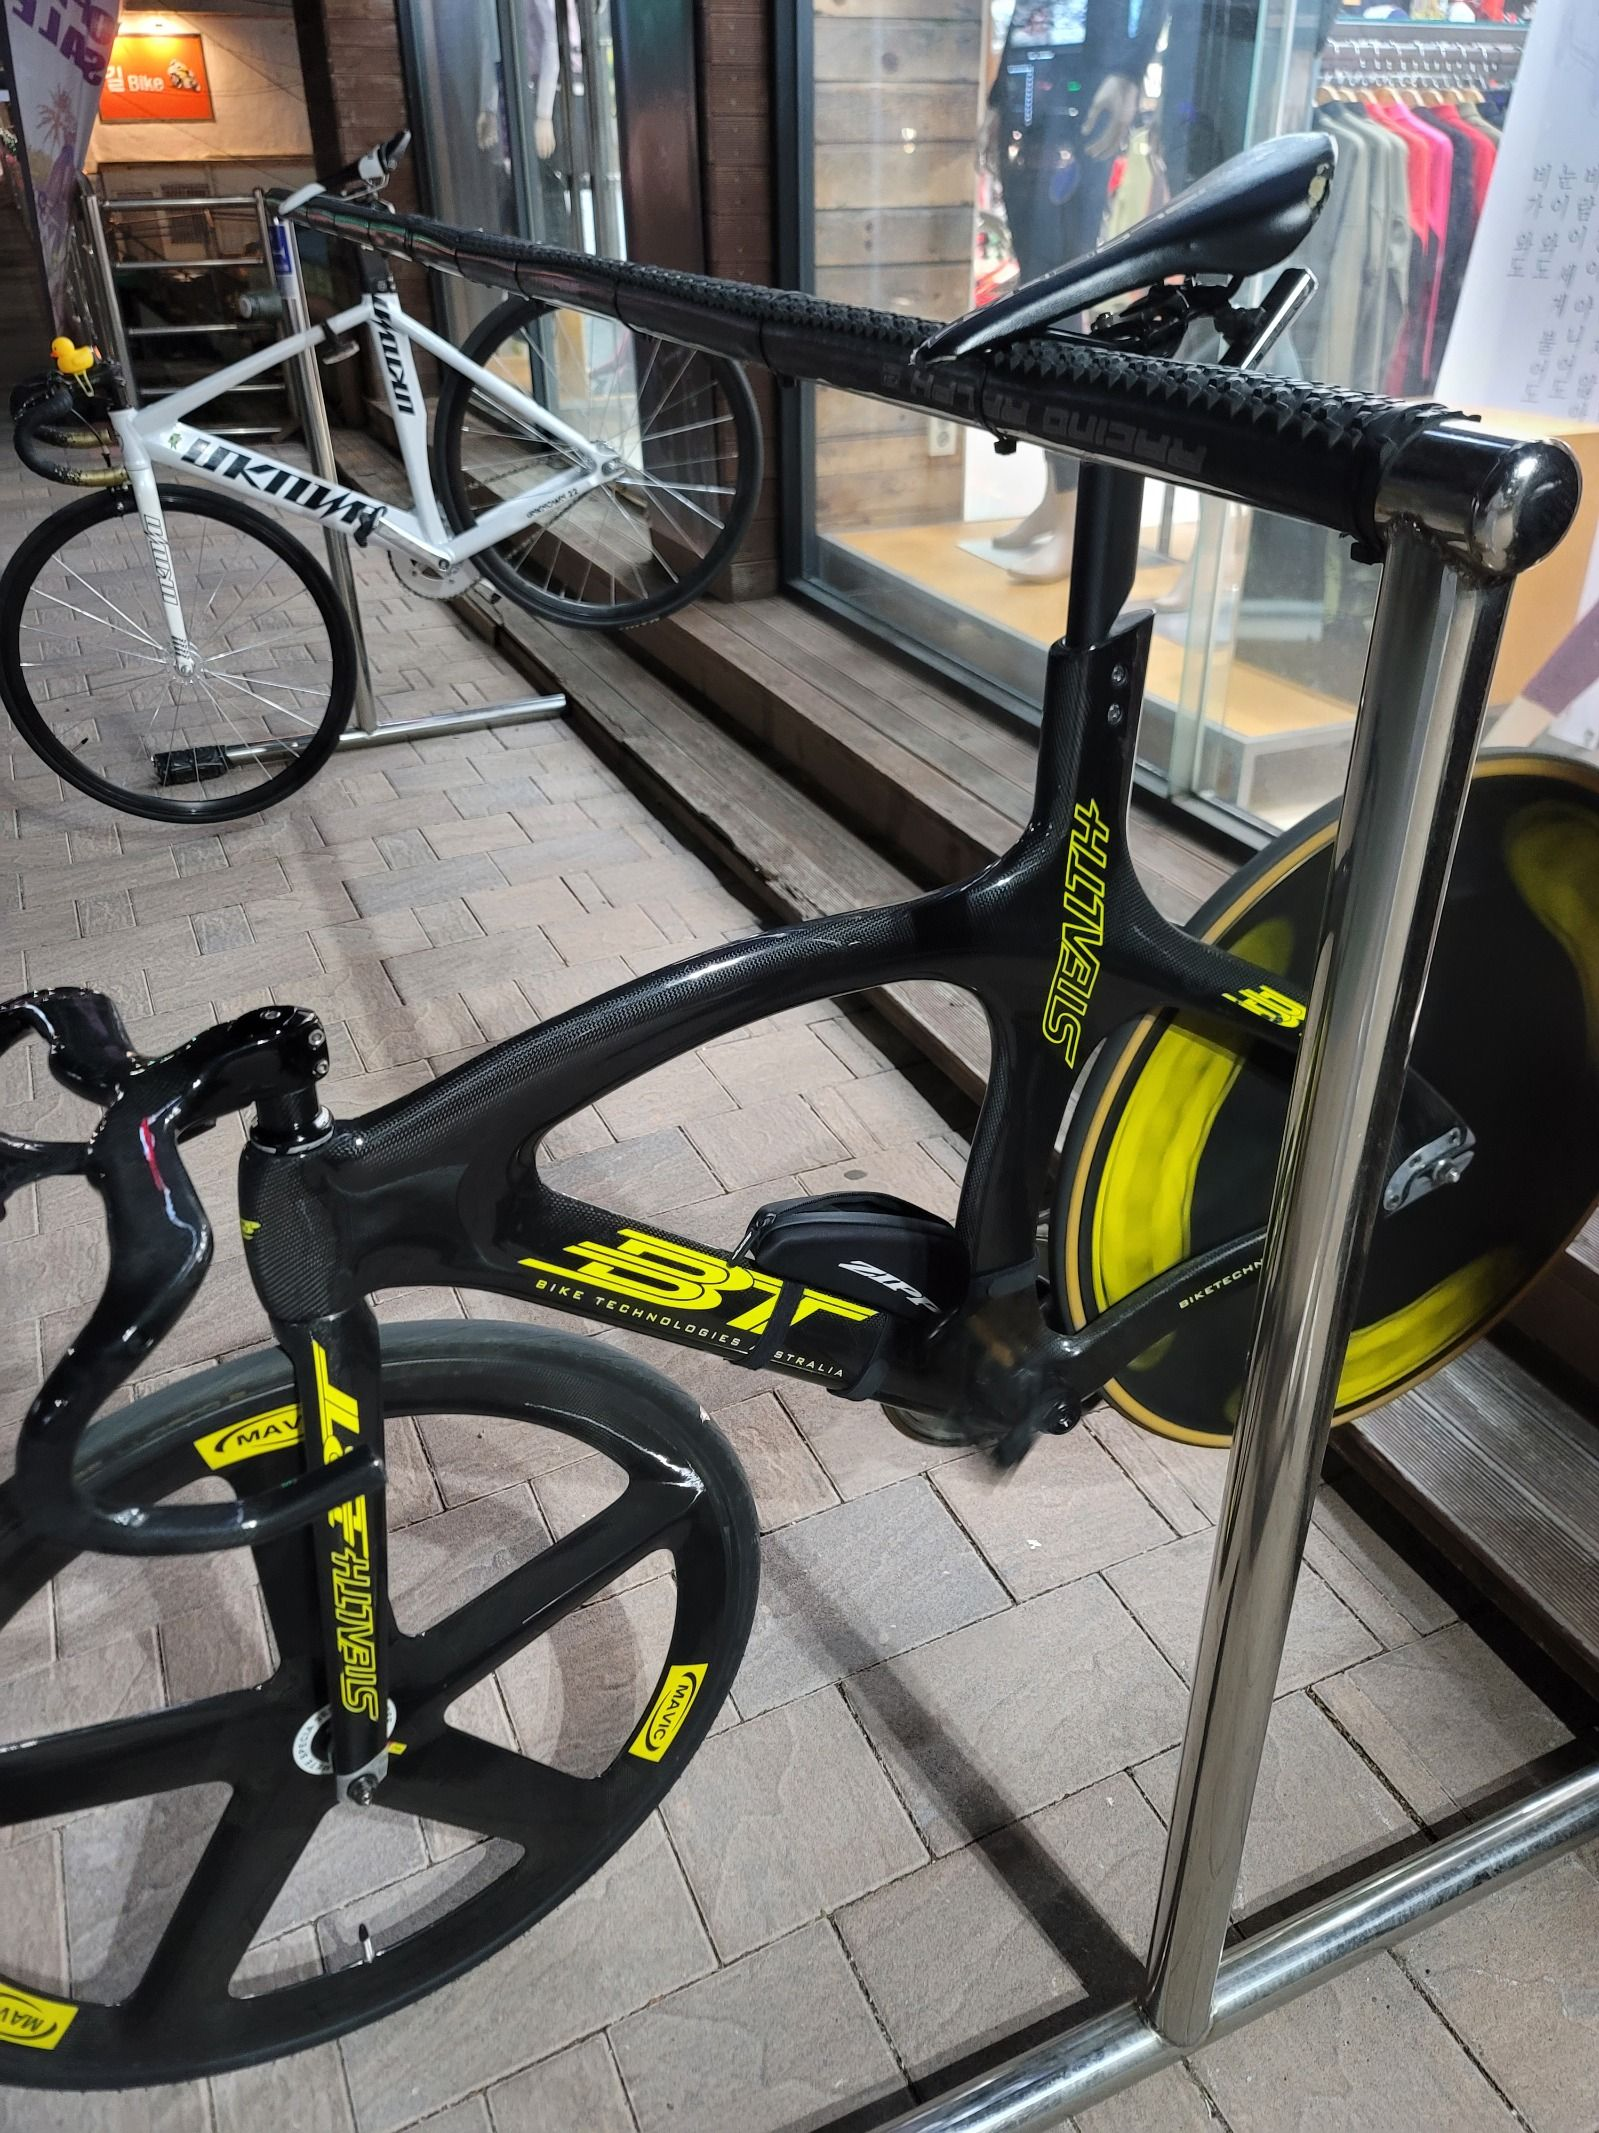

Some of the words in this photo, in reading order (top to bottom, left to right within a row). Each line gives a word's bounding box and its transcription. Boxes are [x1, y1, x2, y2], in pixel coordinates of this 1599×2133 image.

[127, 74, 164, 92] Bike
[1042, 798, 1110, 1069] STEALTH
[1179, 1258, 1264, 1309] BIKETECHN
[536, 1279, 585, 1300] BIKE
[595, 1296, 742, 1347] TECHNOLOGIES
[749, 1344, 844, 1378] STRALIA
[236, 1414, 303, 1446] MAV
[330, 1547, 379, 1722] STEALTH
[653, 1684, 689, 1740] MAVIC
[0, 2007, 45, 2032] MAV
